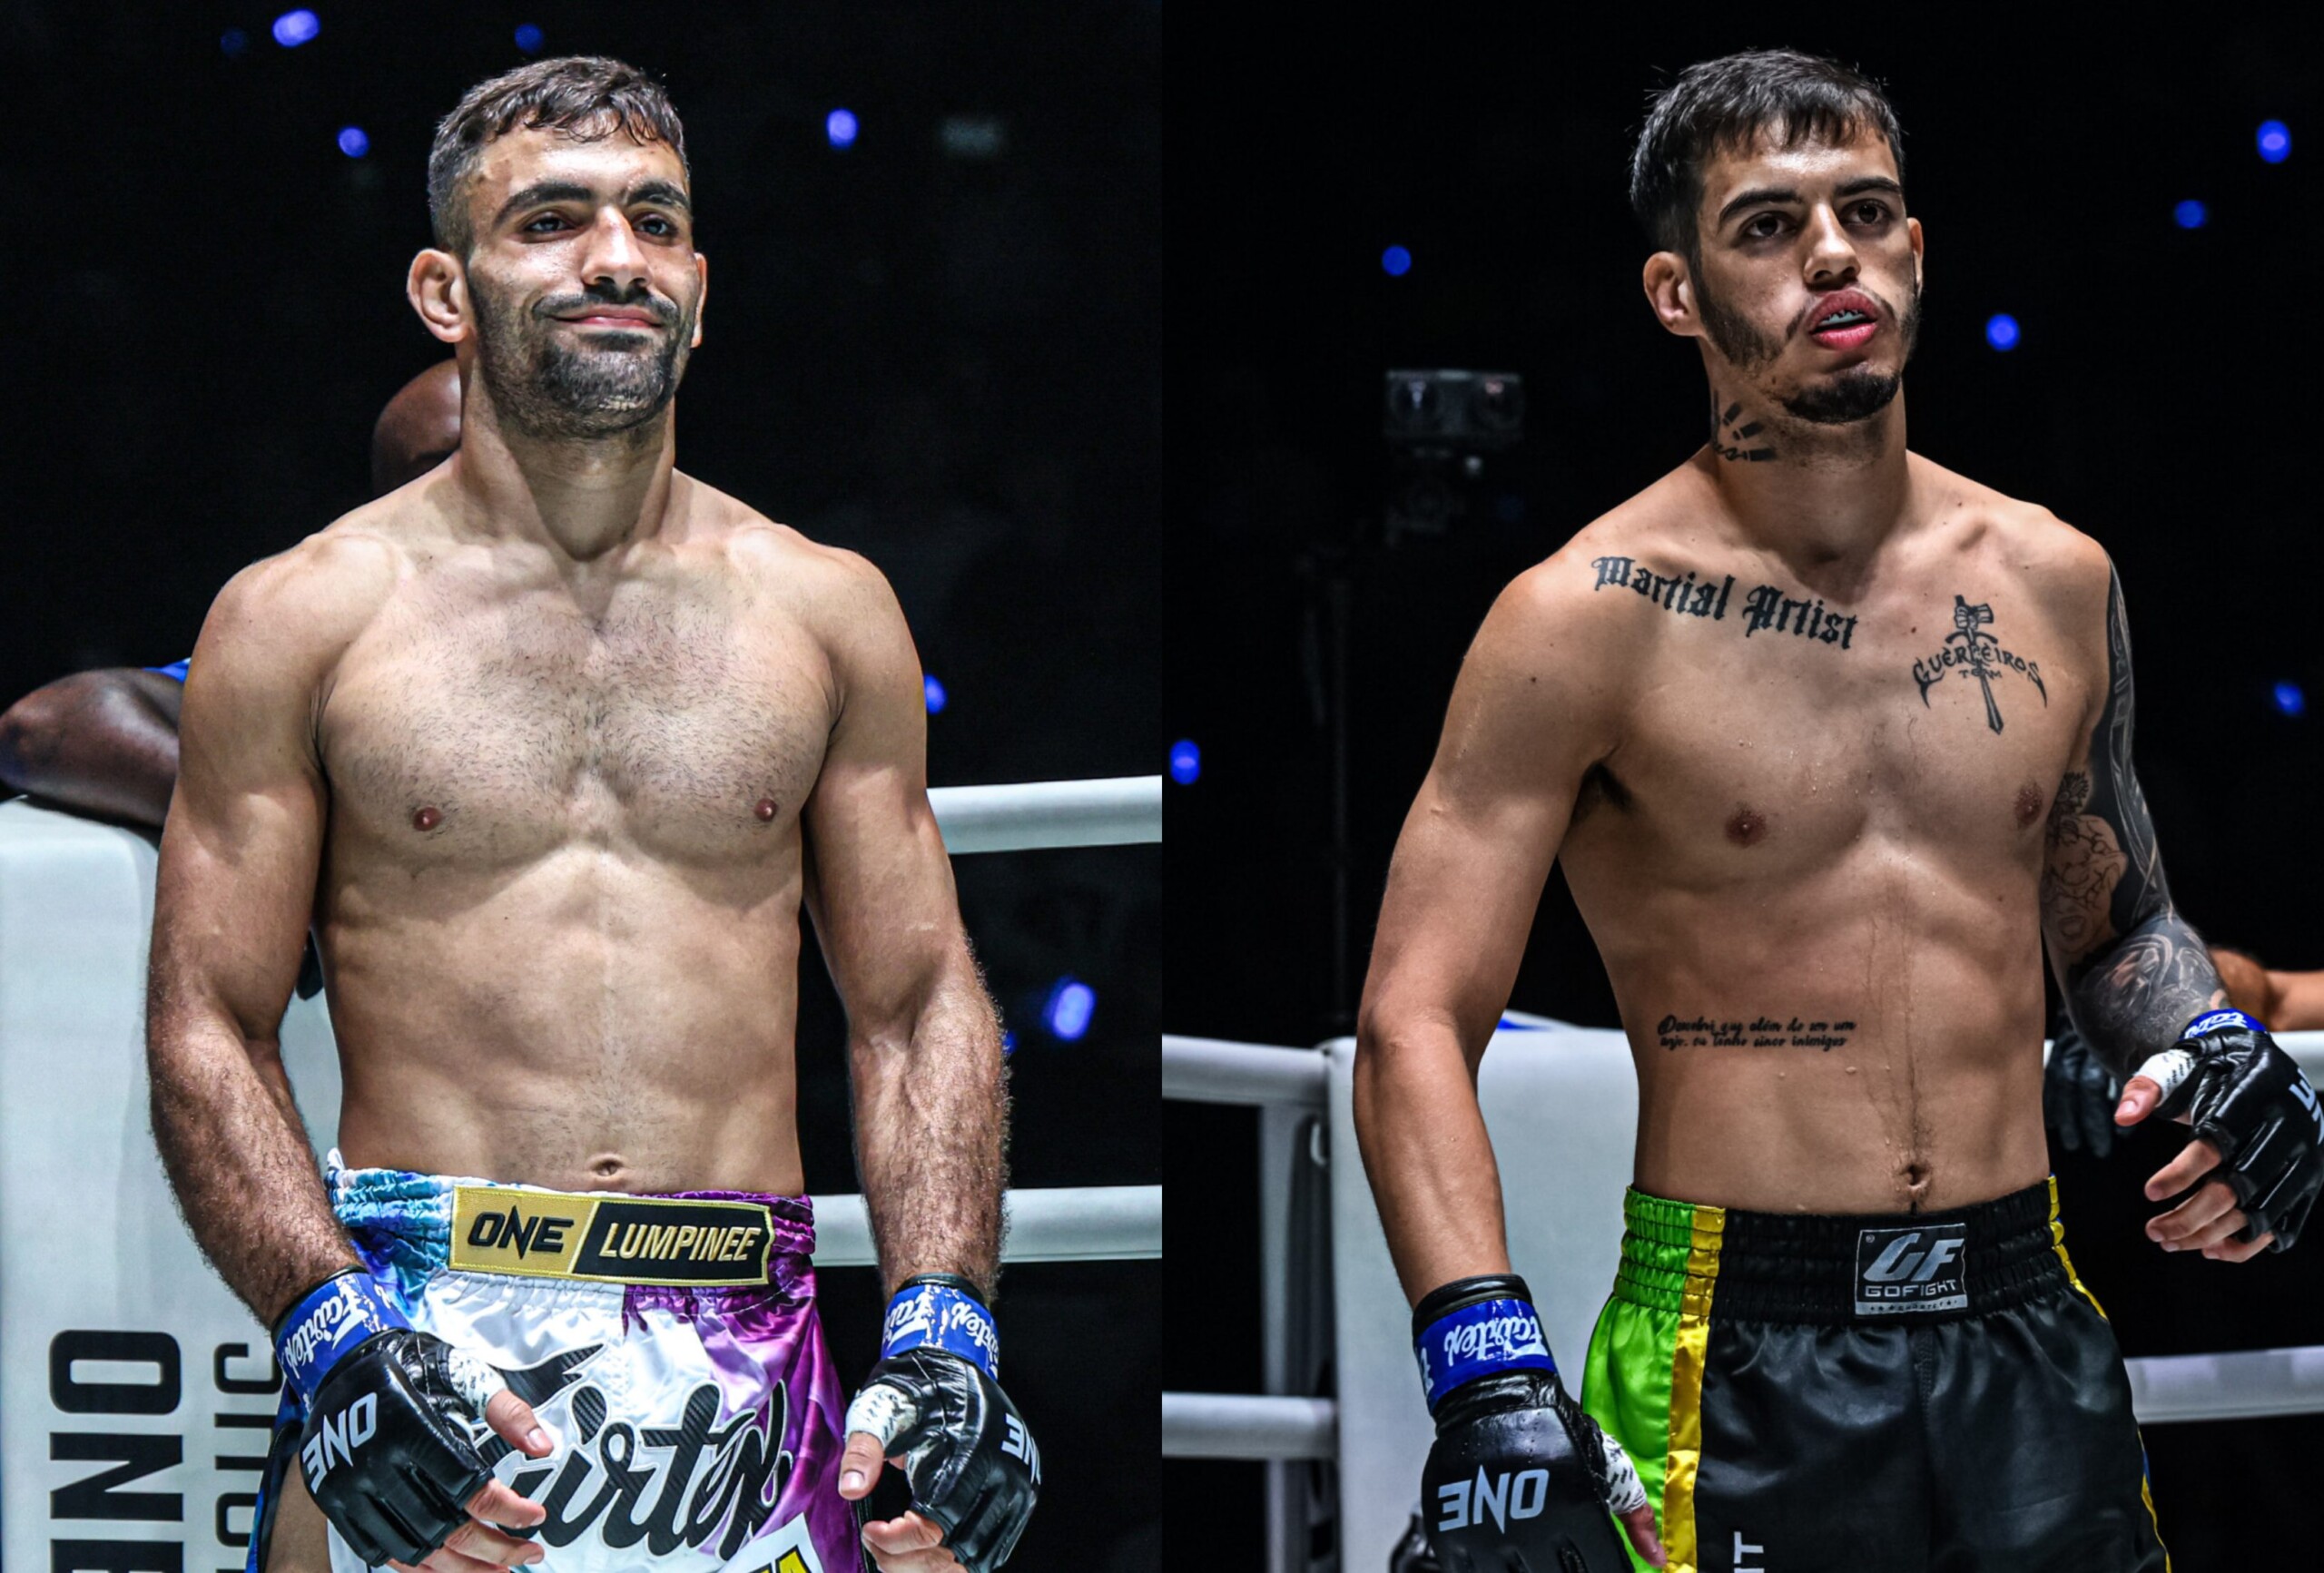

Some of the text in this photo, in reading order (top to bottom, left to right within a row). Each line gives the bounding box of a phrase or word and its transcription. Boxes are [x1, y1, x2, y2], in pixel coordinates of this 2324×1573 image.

[1591, 556, 1858, 650] Martial Artist
[468, 1205, 761, 1262] ONE LUMPINEE
[1865, 1279, 1957, 1298] GOFIGHT
[284, 1283, 369, 1380] Fairtex
[1443, 1315, 1549, 1368] Fairtex
[302, 1392, 378, 1493] ONE
[1437, 1465, 1549, 1534] ONE
